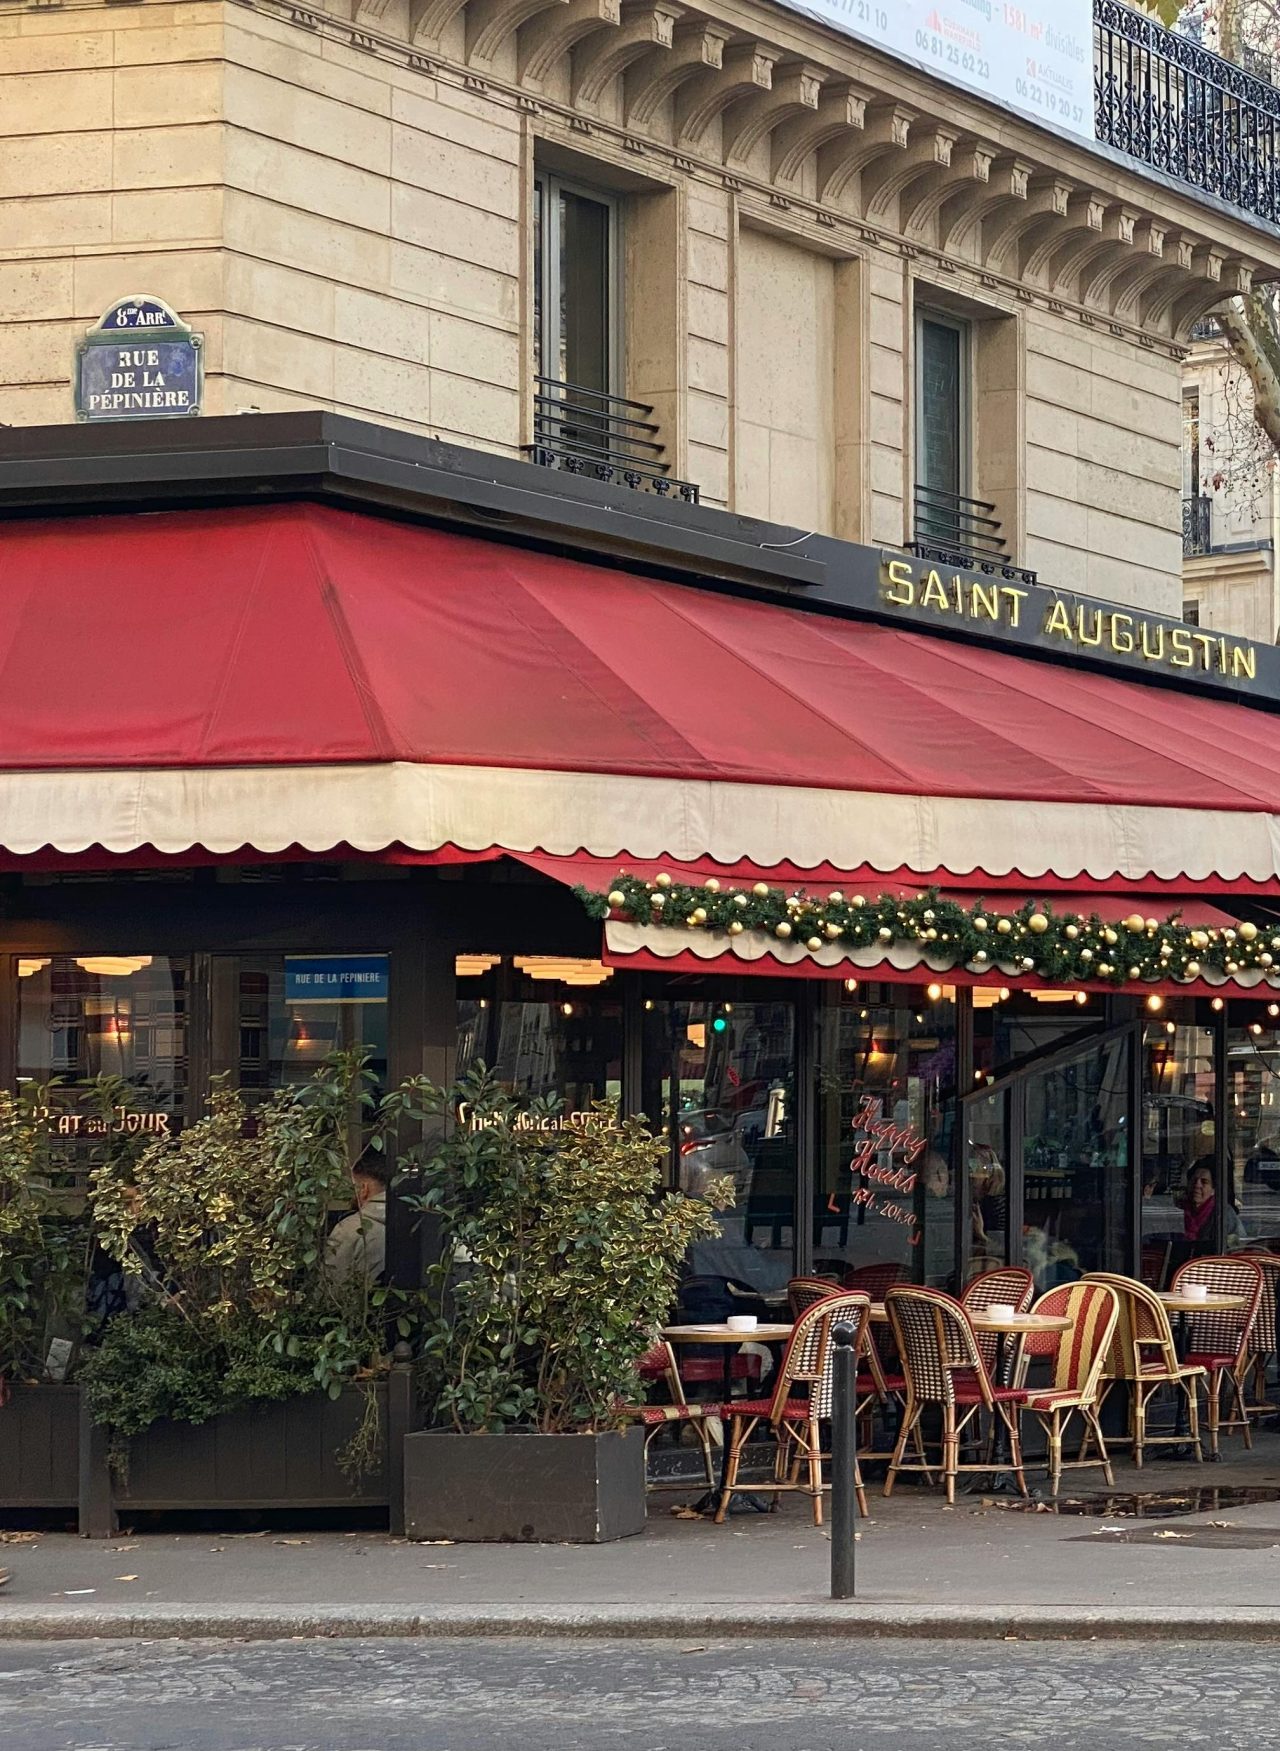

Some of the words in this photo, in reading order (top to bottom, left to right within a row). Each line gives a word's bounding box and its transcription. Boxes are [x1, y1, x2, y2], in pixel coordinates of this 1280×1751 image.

[858, 1, 870, 22] 21
[875, 9, 888, 31] 10
[1003, 3, 1027, 33] 1581
[1045, 24, 1086, 63] divisibles
[915, 29, 929, 49] 06
[931, 36, 944, 57] 81
[946, 44, 960, 65] 25
[962, 52, 975, 72] 62
[977, 58, 990, 79] 23
[1015, 77, 1028, 98] 06
[1030, 84, 1043, 105] 22
[1045, 91, 1056, 111] 19
[1058, 98, 1071, 118] 20
[1073, 105, 1084, 123] 57
[119, 350, 159, 367] RUE
[88, 387, 190, 410] PÉPINIÈRE
[111, 372, 136, 389] DE
[142, 371, 166, 388] LA
[885, 559, 1029, 628] SAINT
[1045, 600, 1256, 680] AUGUSTIN
[295, 973, 311, 984] RUE
[314, 973, 325, 984] DE
[327, 973, 338, 983] LA
[340, 972, 380, 983] PEPINIERE
[851, 1094, 928, 1164] Happy
[850, 1140, 918, 1194] Hours
[879, 1200, 918, 1227] 20h30
